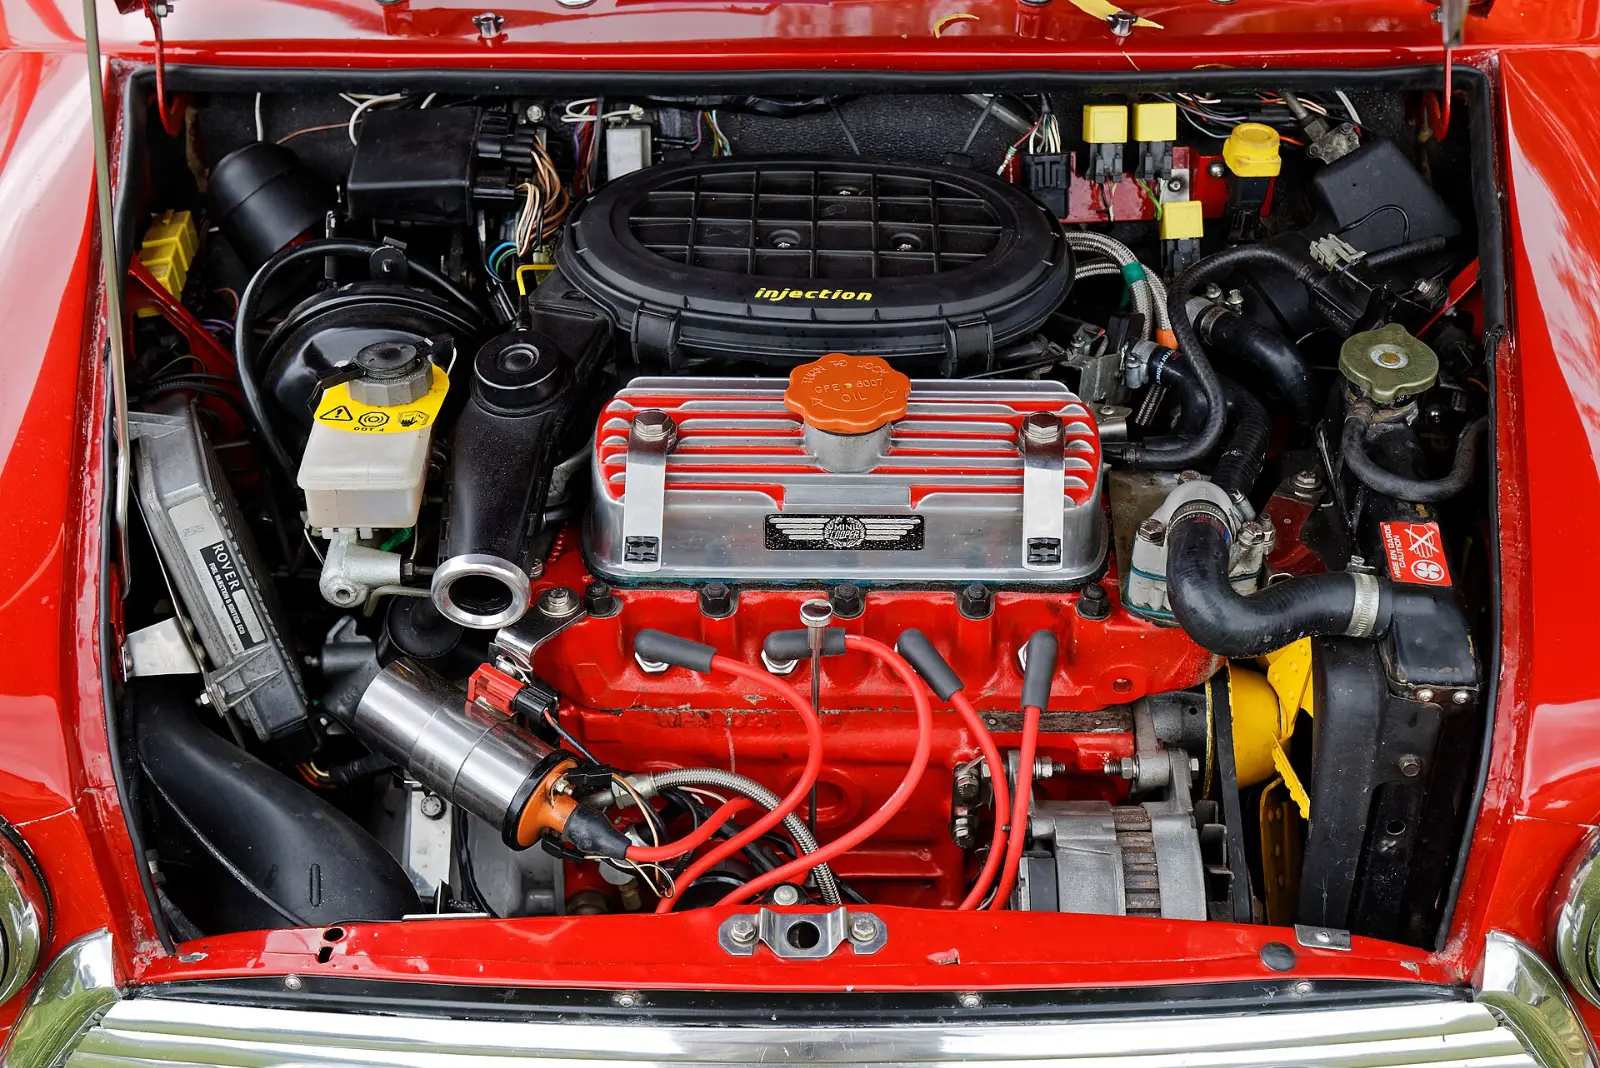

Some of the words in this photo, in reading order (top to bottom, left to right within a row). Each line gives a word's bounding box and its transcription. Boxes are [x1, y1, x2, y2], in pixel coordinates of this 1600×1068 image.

[754, 287, 873, 302] injection
[801, 365, 827, 384] TURN
[829, 359, 848, 367] TO
[857, 361, 889, 377] LOCK
[842, 393, 867, 402] OIL
[829, 530, 860, 539] COOPER
[1383, 524, 1395, 549] GARDE
[1389, 549, 1398, 561] EN
[1393, 535, 1407, 568] CAUTION
[212, 543, 240, 591] ROVER
[1391, 561, 1402, 579] MISE
[208, 562, 219, 576] FUEL
[236, 624, 246, 635] ECU
